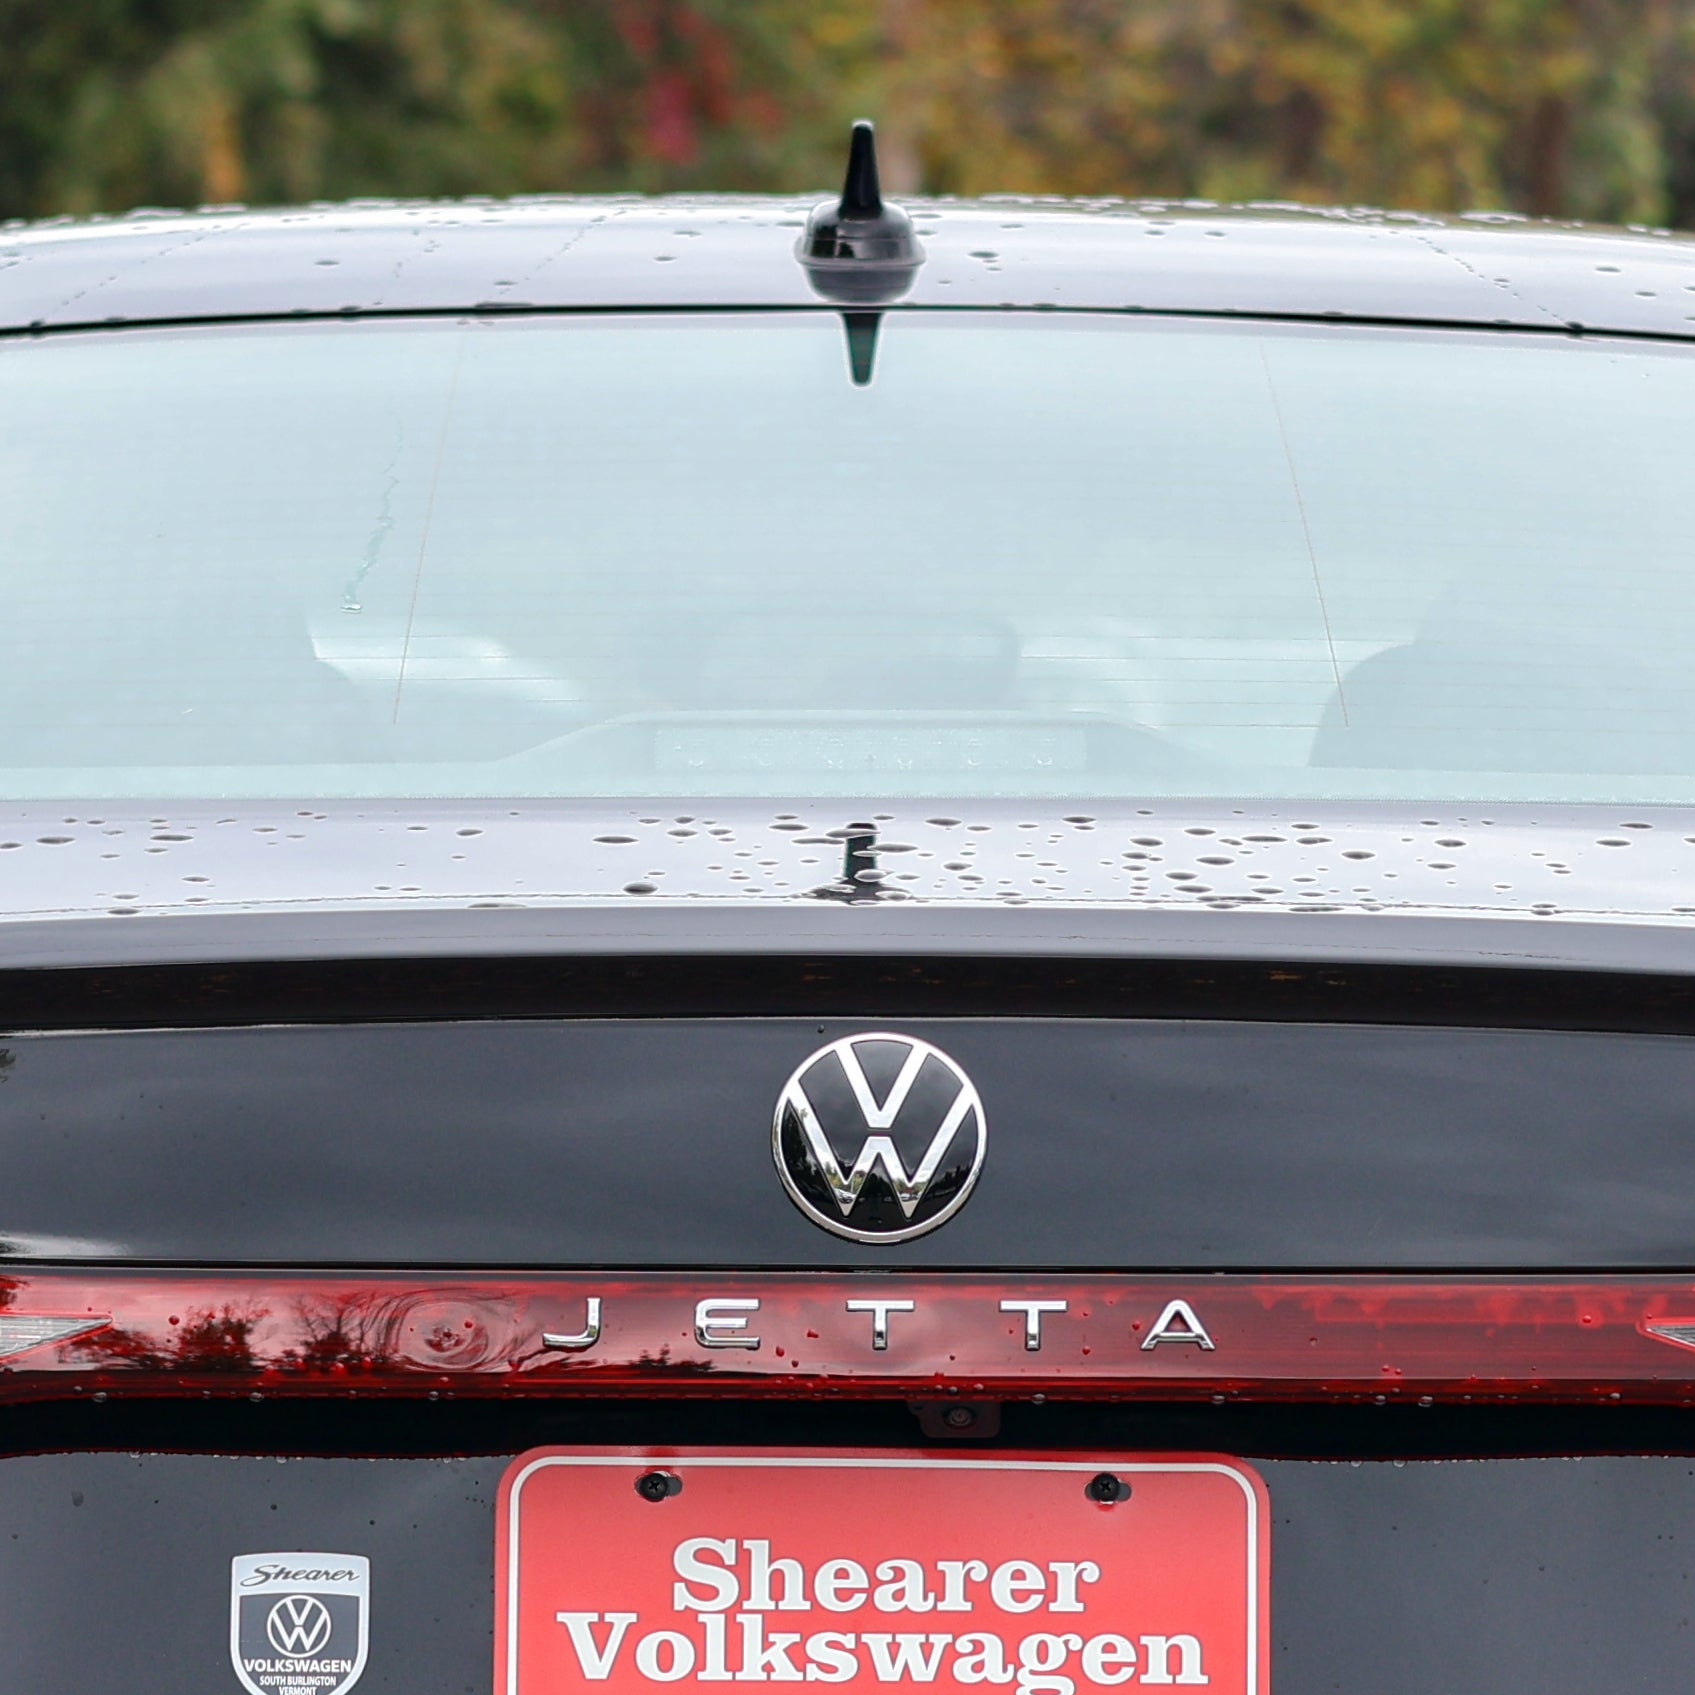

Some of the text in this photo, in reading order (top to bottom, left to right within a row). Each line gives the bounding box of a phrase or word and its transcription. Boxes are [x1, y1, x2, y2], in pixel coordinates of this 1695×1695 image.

[541, 1296, 1216, 1352] JETTA
[239, 1563, 361, 1588] Shearer
[671, 1536, 1101, 1614] Shearer
[242, 1658, 353, 1673] VOLKSWAGEN
[259, 1675, 337, 1687] SOUTH BURLINGTON
